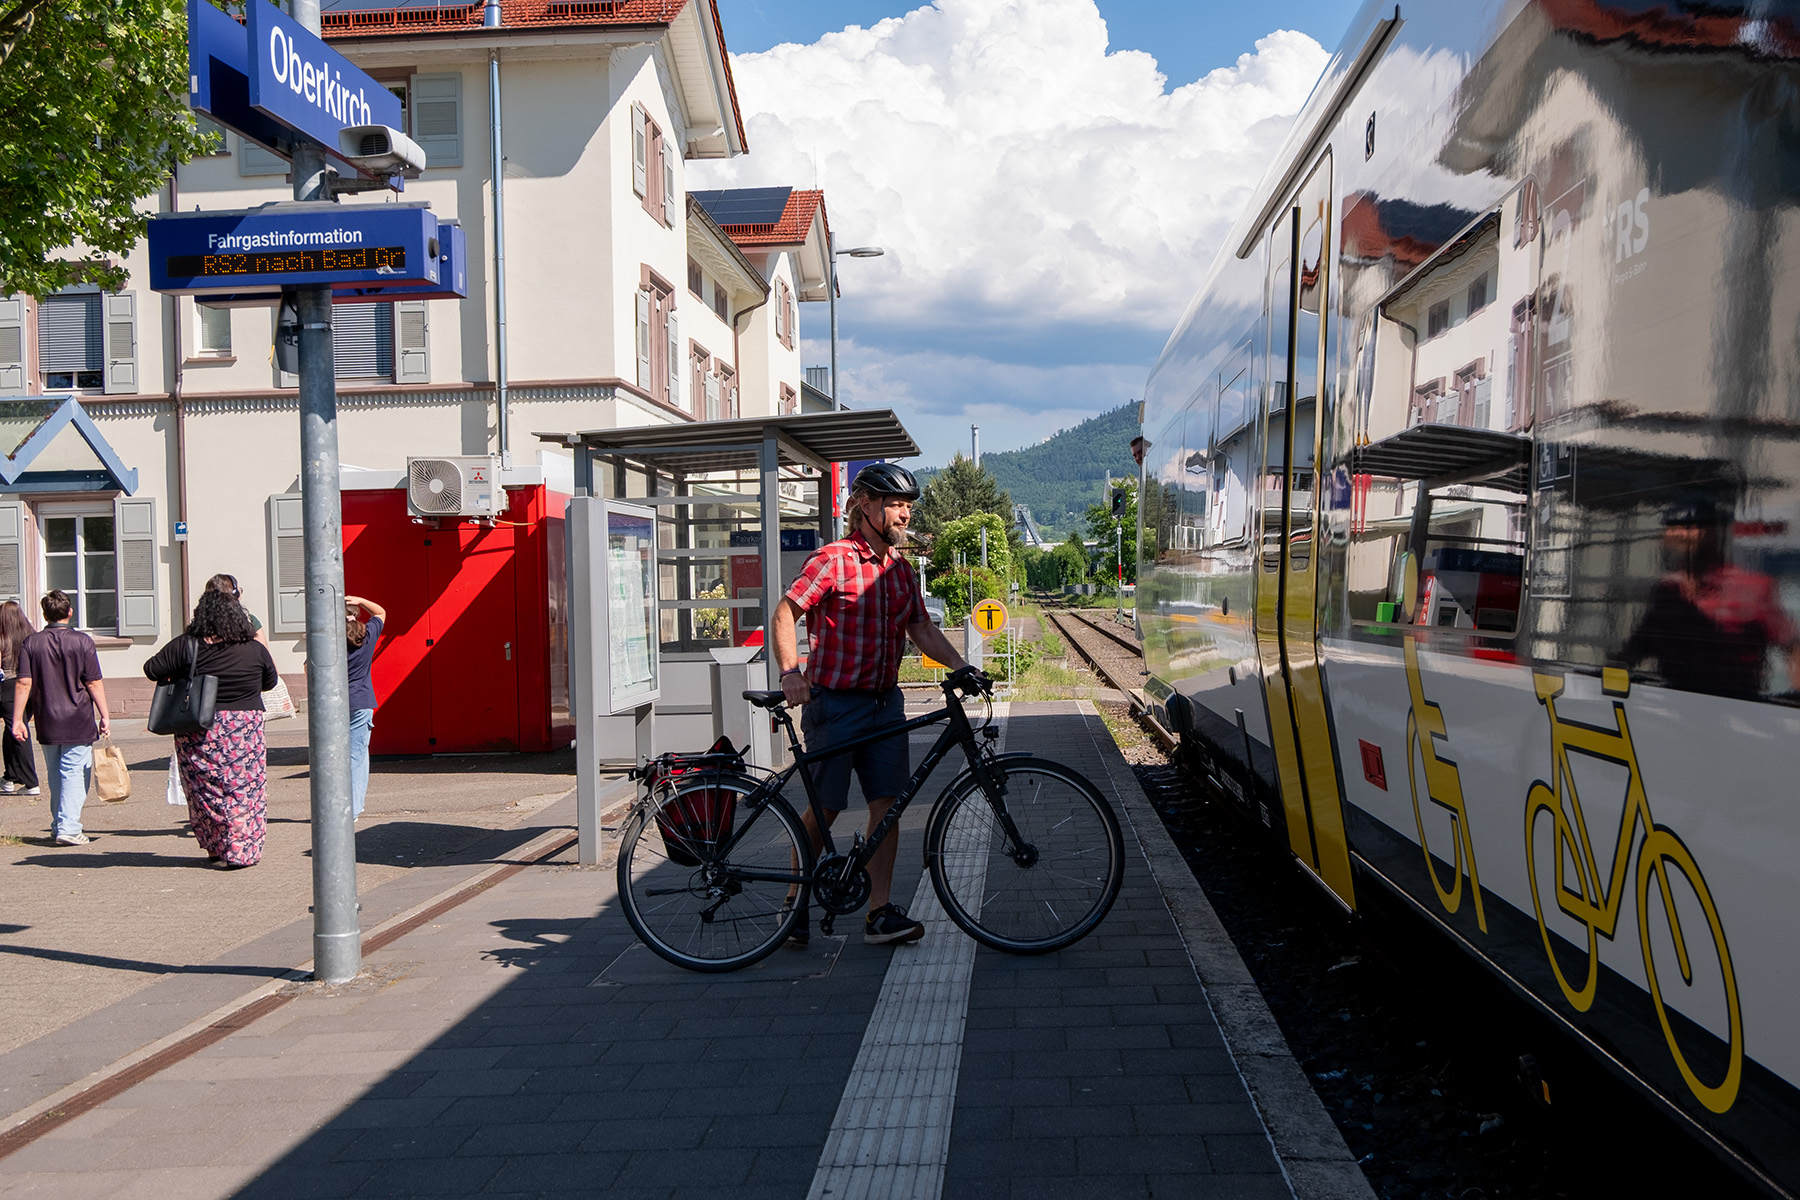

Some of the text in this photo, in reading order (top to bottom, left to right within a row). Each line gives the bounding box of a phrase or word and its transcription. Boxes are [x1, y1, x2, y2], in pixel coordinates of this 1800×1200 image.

[269, 26, 371, 126] Oberkirch
[208, 228, 363, 250] Fahrgastinformation
[203, 247, 406, 274] RS2 nach Bad Gr
